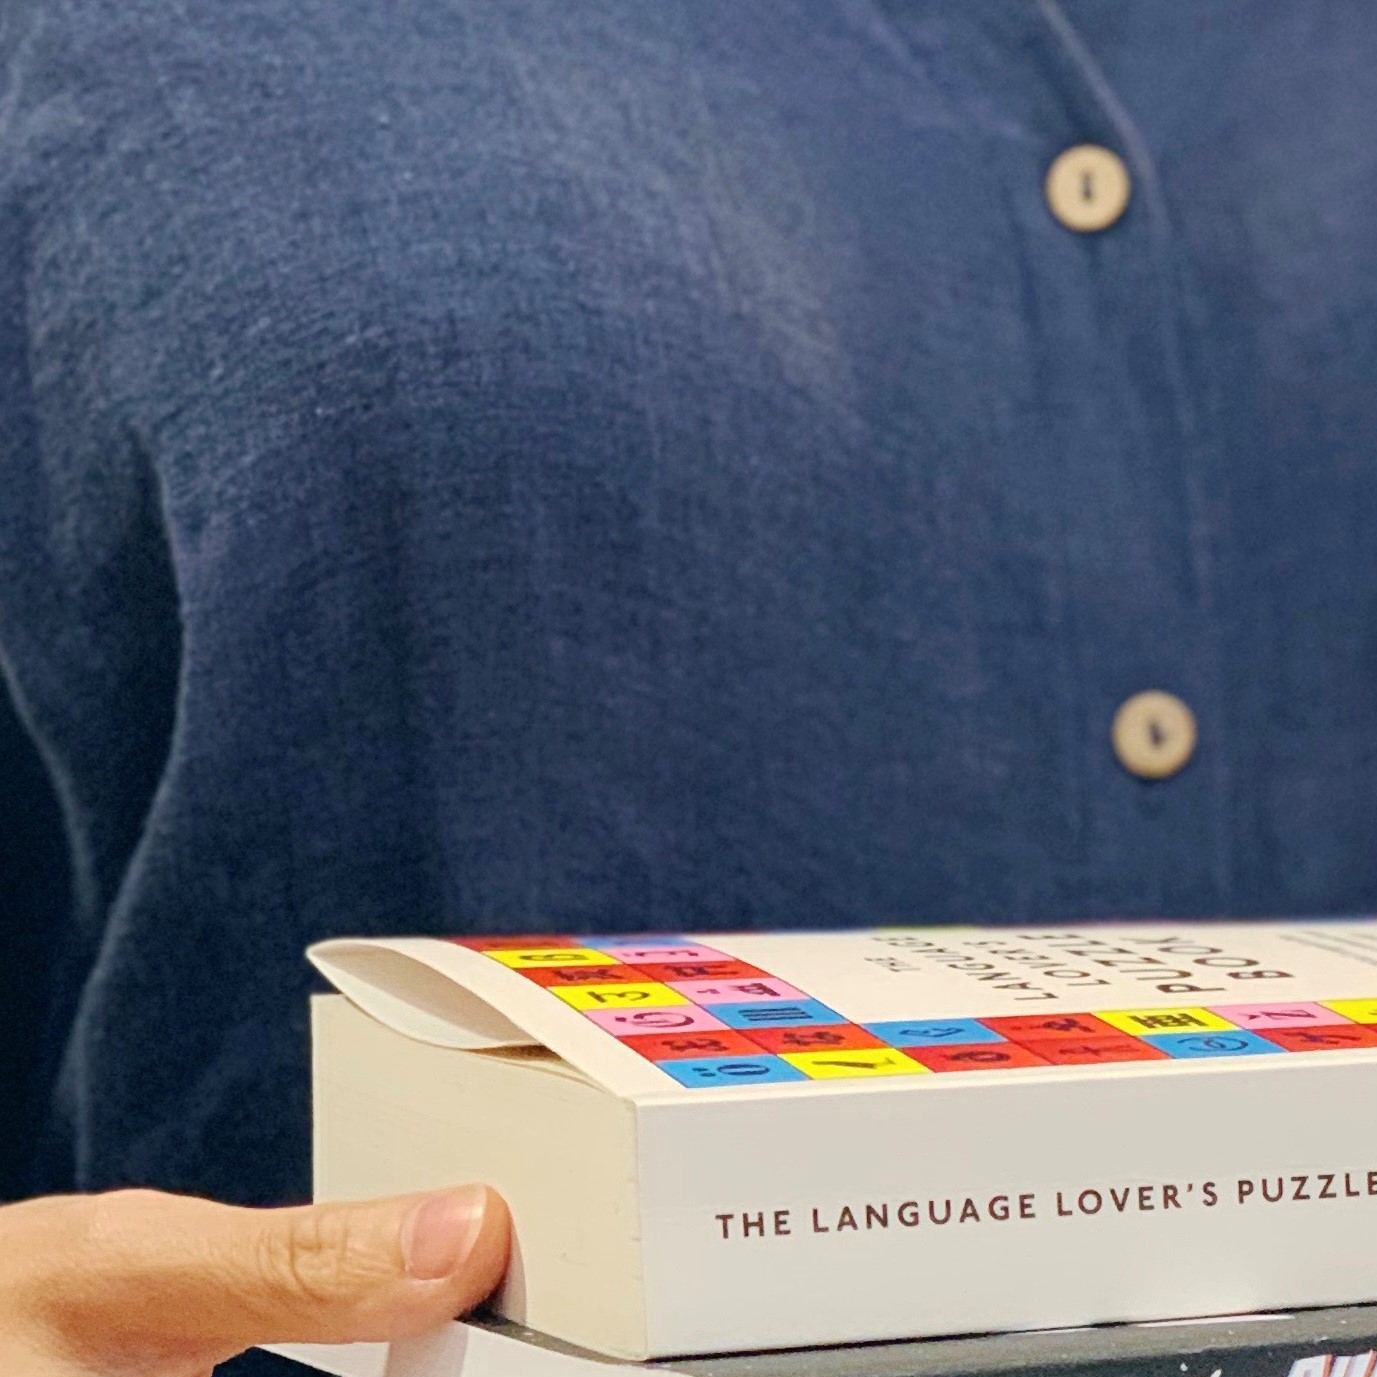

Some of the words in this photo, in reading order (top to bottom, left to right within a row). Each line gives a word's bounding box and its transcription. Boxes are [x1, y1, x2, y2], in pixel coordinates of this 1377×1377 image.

[865, 956, 922, 973] THE
[873, 936, 1058, 1001] LANGUAGE
[1018, 933, 1226, 994] PUZZLE
[1122, 935, 1295, 980] BOOK
[716, 1213, 791, 1239] THE
[813, 1194, 1037, 1234] LANGUAGE
[1057, 1181, 1220, 1218] LOVER'S
